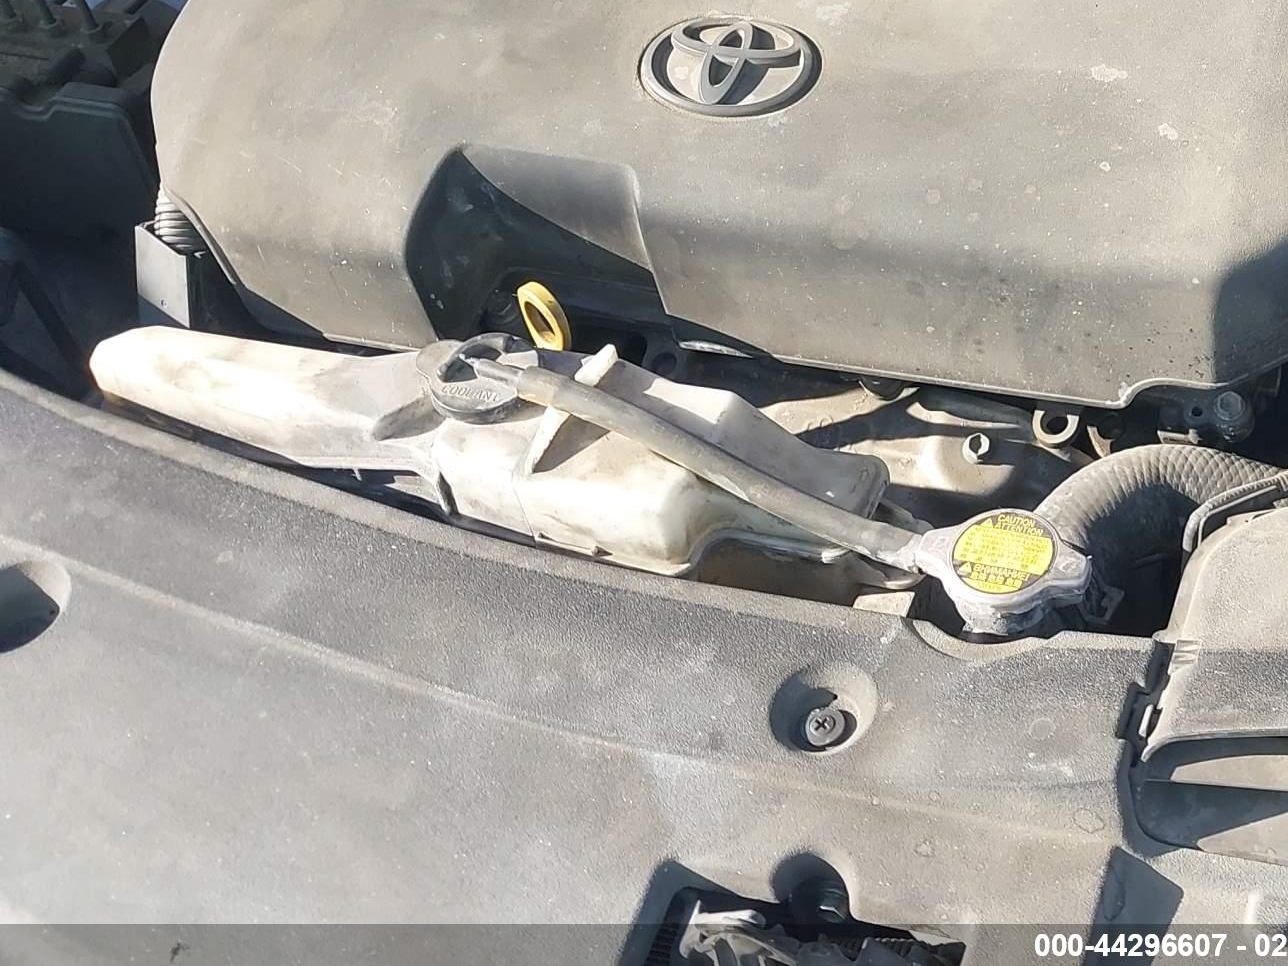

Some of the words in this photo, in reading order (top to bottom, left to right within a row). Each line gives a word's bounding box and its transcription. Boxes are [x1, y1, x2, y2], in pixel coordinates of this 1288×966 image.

[441, 384, 499, 403] COOLANT
[994, 521, 1044, 538] ATTENTION
[997, 514, 1036, 528] CAUTION
